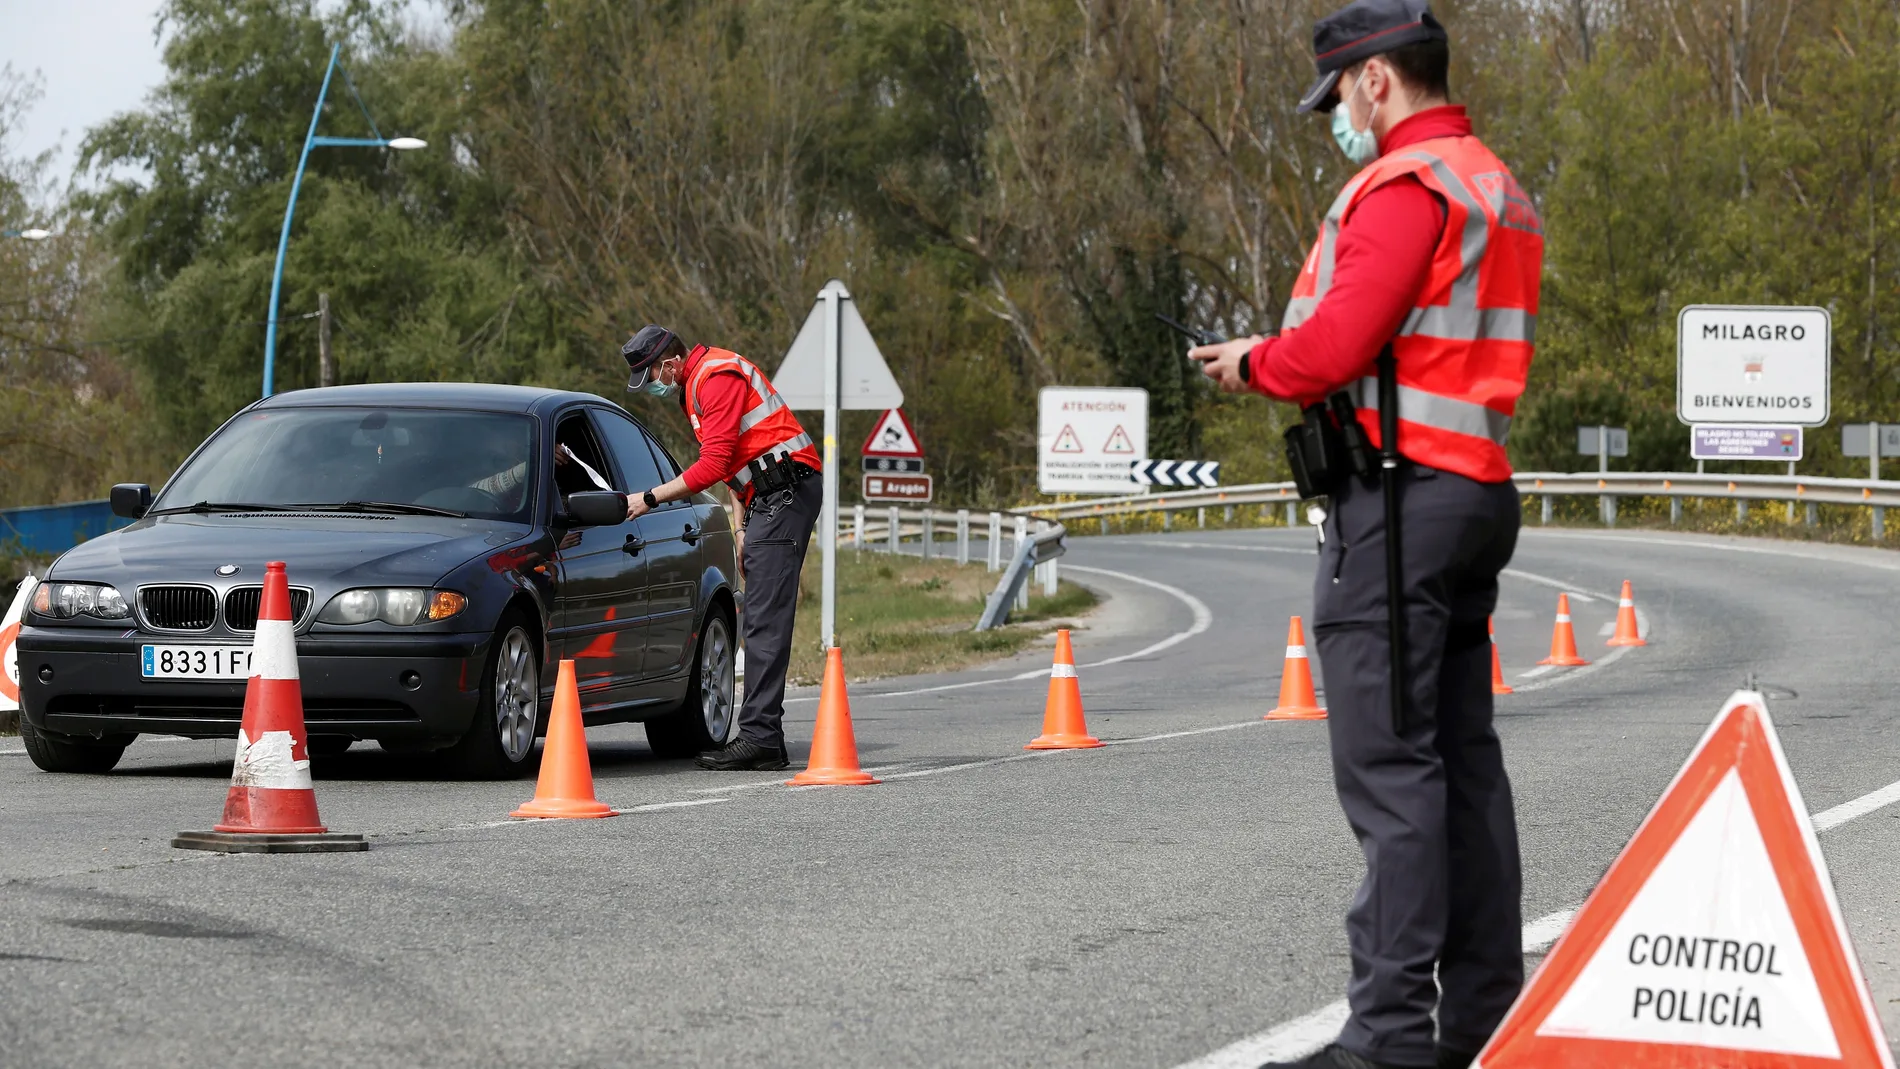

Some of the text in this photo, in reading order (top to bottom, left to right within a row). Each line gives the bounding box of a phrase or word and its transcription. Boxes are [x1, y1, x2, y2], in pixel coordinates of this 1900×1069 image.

[1702, 324, 1806, 340] MILAGRO
[1062, 401, 1126, 412] ATENCIÓN
[1694, 395, 1812, 409] BIENVENIDOS
[887, 482, 926, 495] Aragón
[160, 650, 220, 674] 8331
[1628, 933, 1783, 976] CONTROL
[1633, 986, 1762, 1029] POLICÍA
